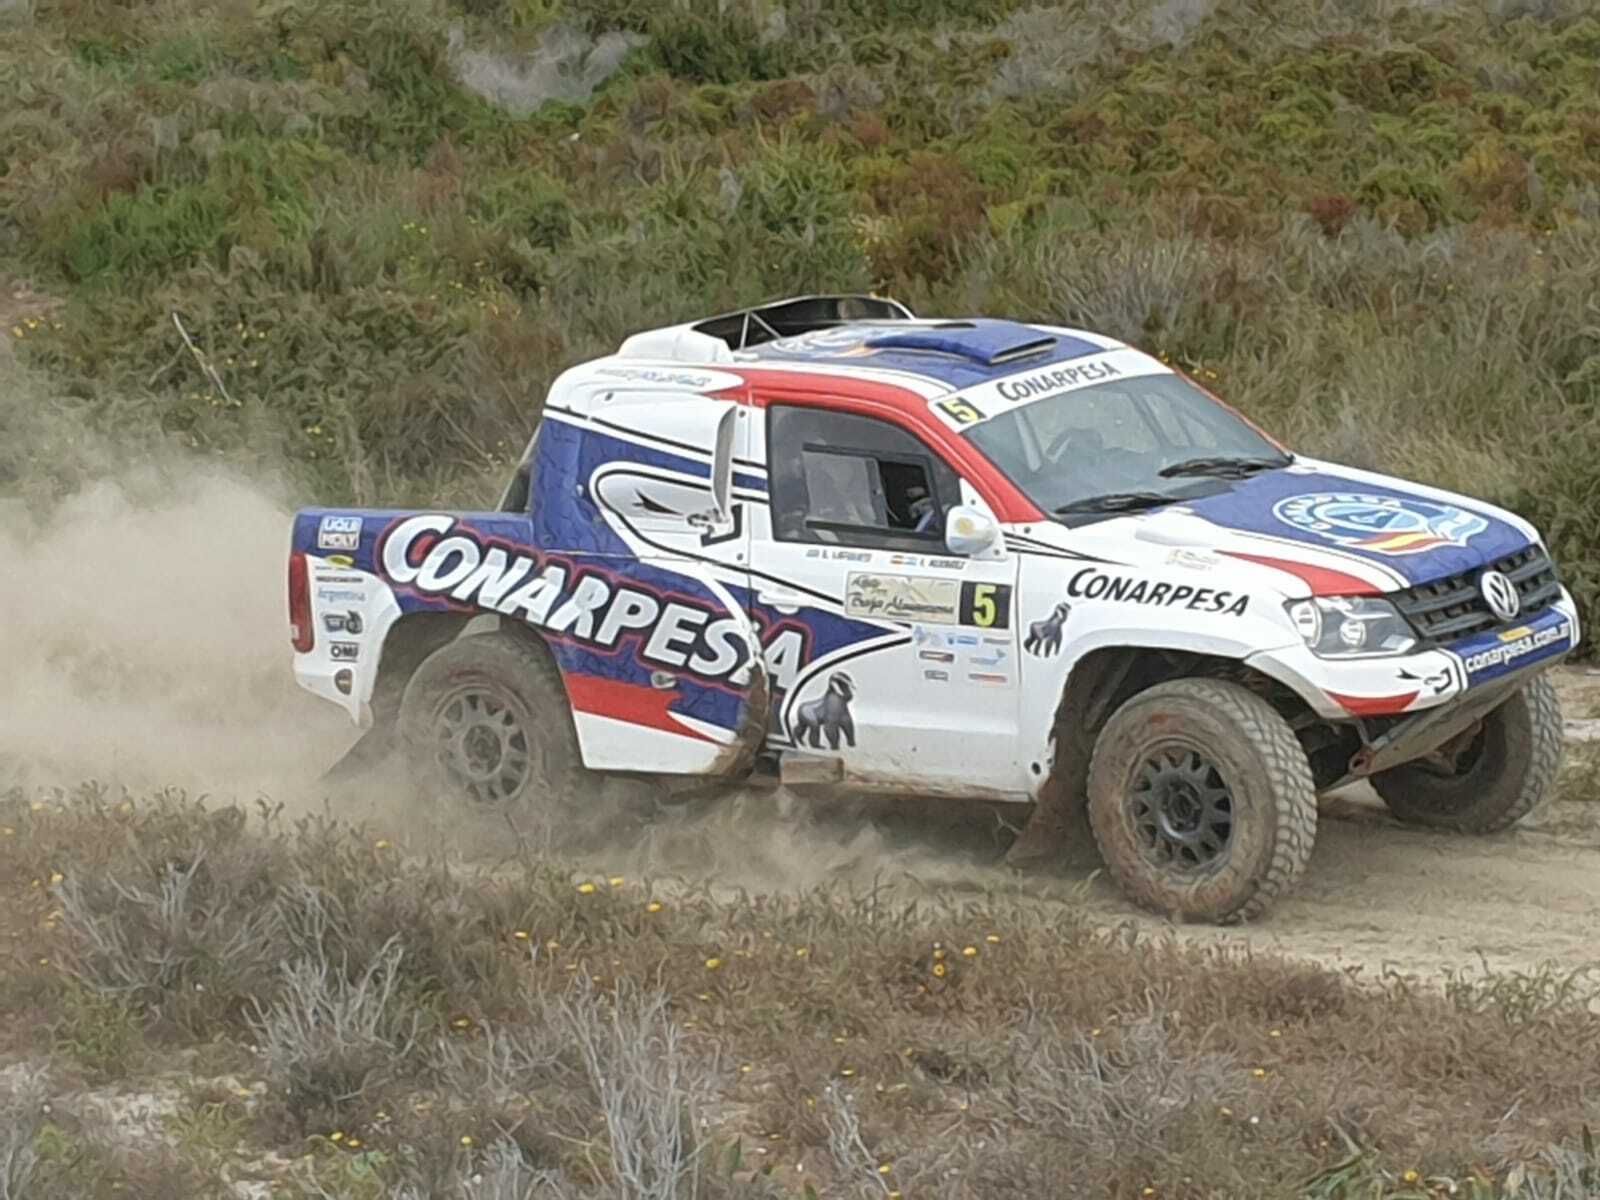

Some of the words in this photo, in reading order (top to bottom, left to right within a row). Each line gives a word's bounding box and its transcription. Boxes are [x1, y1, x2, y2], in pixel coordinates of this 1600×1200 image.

[995, 361, 1122, 402] CONARPESA
[942, 398, 980, 424] 5
[381, 514, 803, 690] CONARPESA
[972, 583, 997, 628] 5
[1066, 567, 1251, 617] CONARPESA
